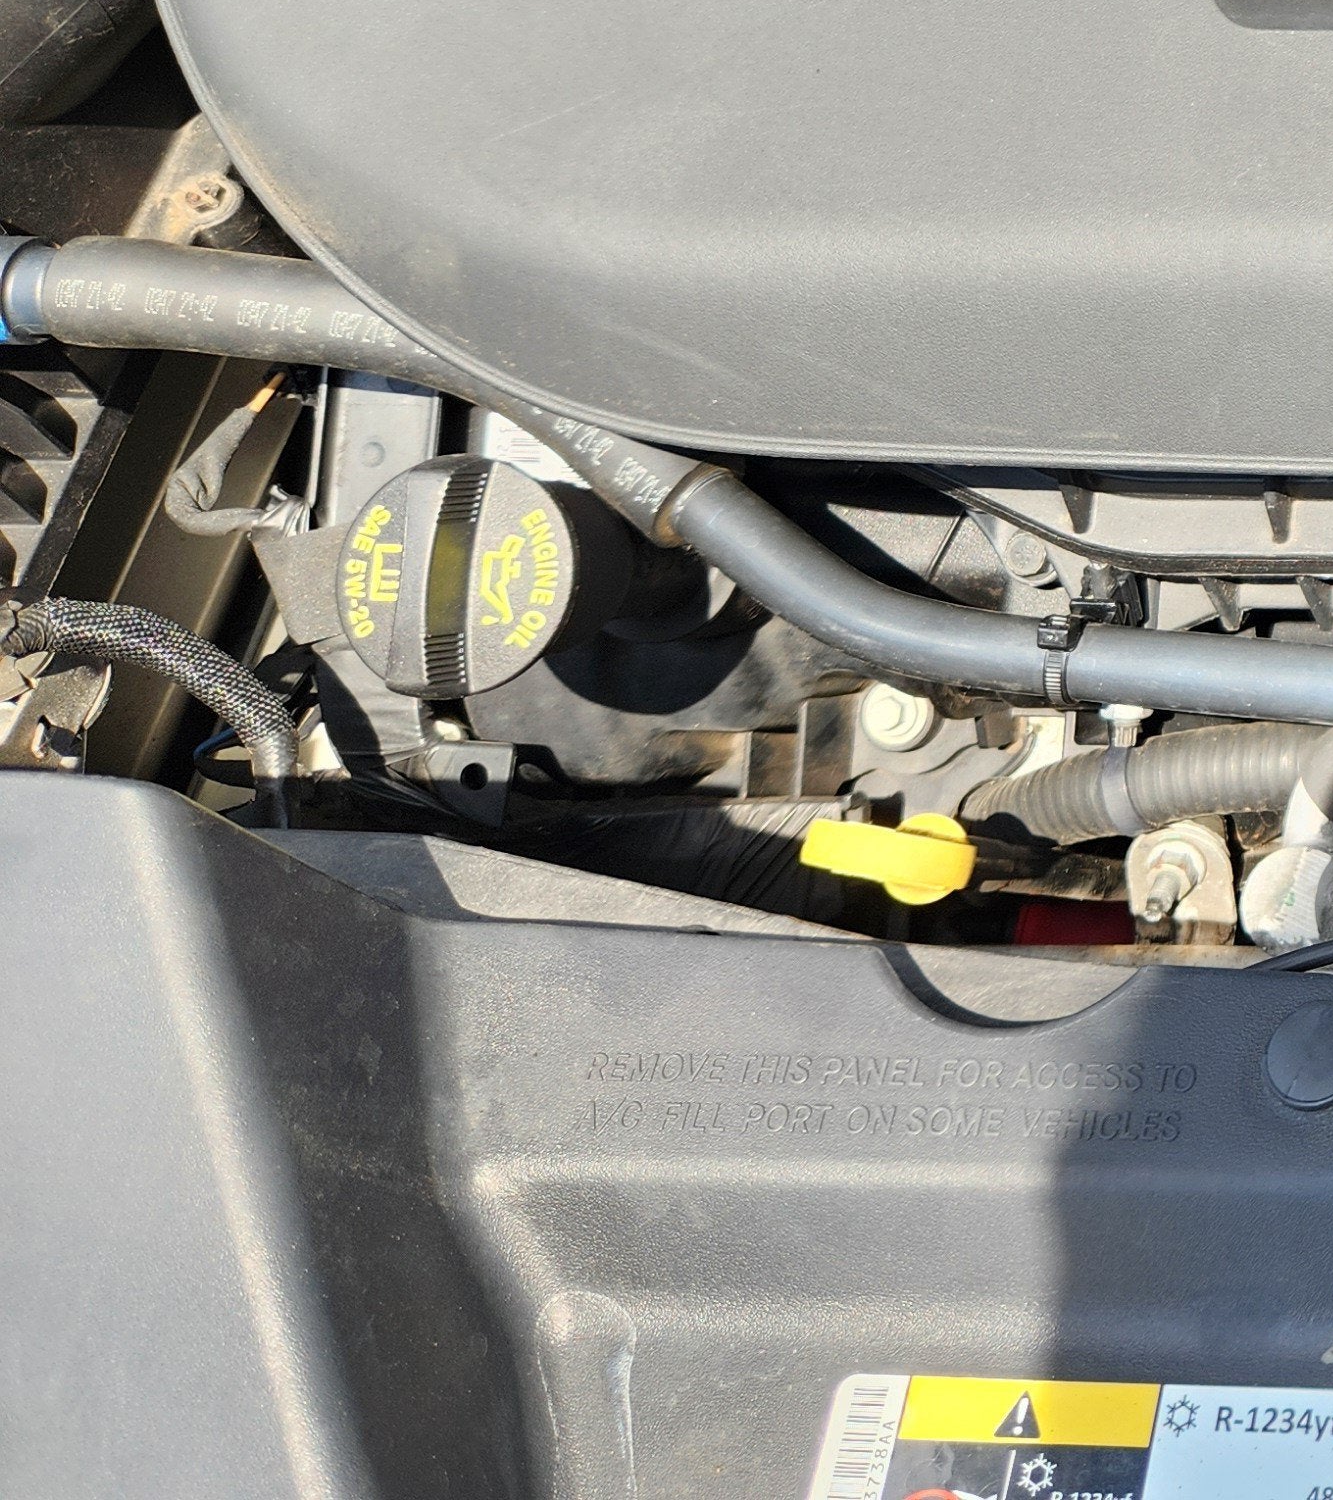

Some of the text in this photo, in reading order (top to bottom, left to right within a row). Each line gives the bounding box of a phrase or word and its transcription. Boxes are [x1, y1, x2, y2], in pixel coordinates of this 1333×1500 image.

[344, 504, 392, 639] SAE 5W-20
[504, 508, 559, 649] ENGINE OIL
[587, 1052, 1198, 1093] REMOVE THIS PANEL FOR ACCESS TO
[575, 1097, 1182, 1142] A/C FILL PORT ON SOME VEHICLES
